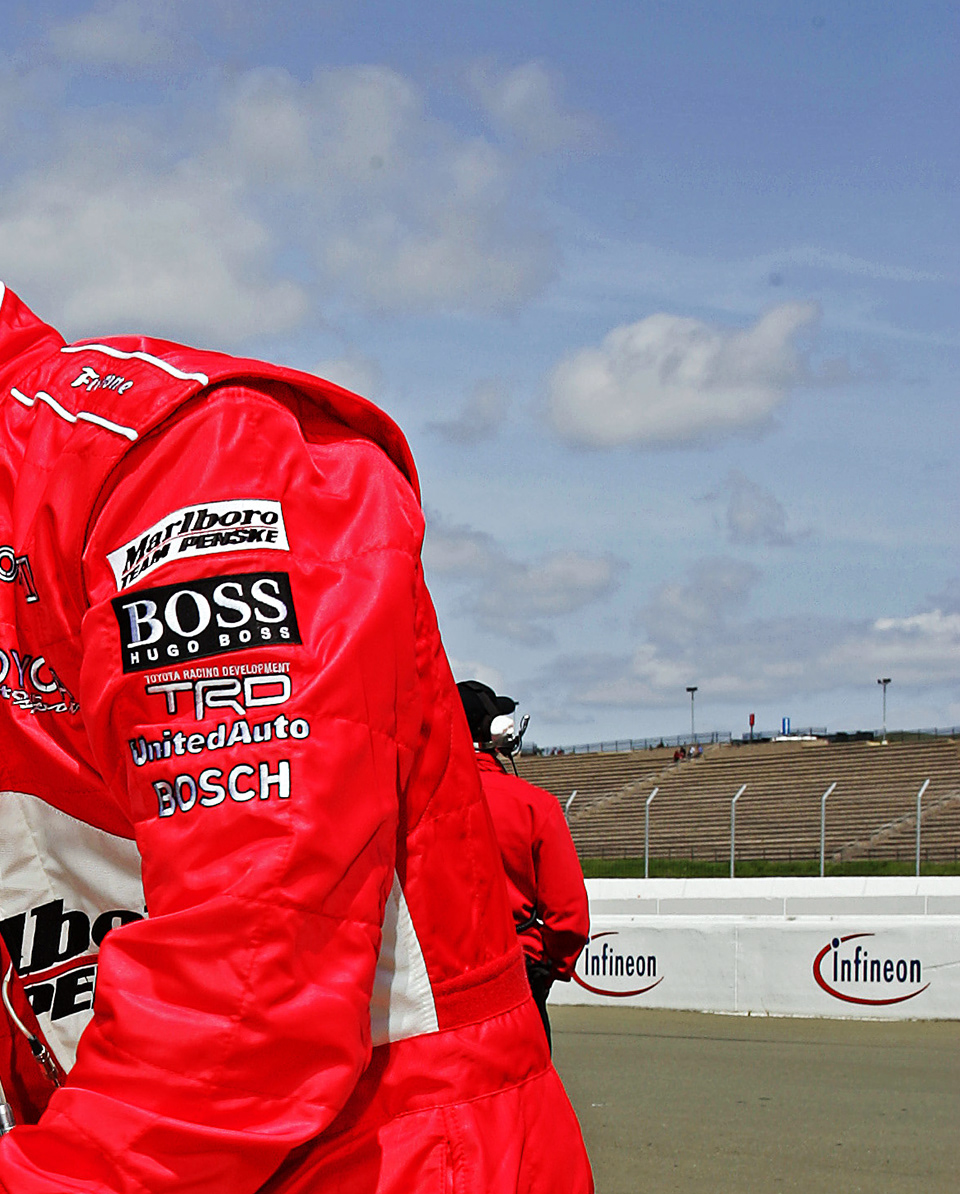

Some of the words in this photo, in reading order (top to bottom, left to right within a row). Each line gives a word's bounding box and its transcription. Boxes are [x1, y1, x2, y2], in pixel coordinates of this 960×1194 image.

[121, 543, 171, 590] TEAM
[178, 528, 279, 553] PENSKE
[122, 509, 279, 576] Marlboro
[122, 578, 289, 648] BOSS
[130, 640, 200, 664] HUGO
[218, 627, 291, 647] BOSS
[144, 668, 181, 684] TOYOTA
[183, 666, 220, 680] RACING
[222, 663, 291, 677] DEVELOPMENT
[146, 674, 291, 721] TRD
[129, 714, 310, 766] UnitedAuto
[152, 760, 291, 818] BOSCH
